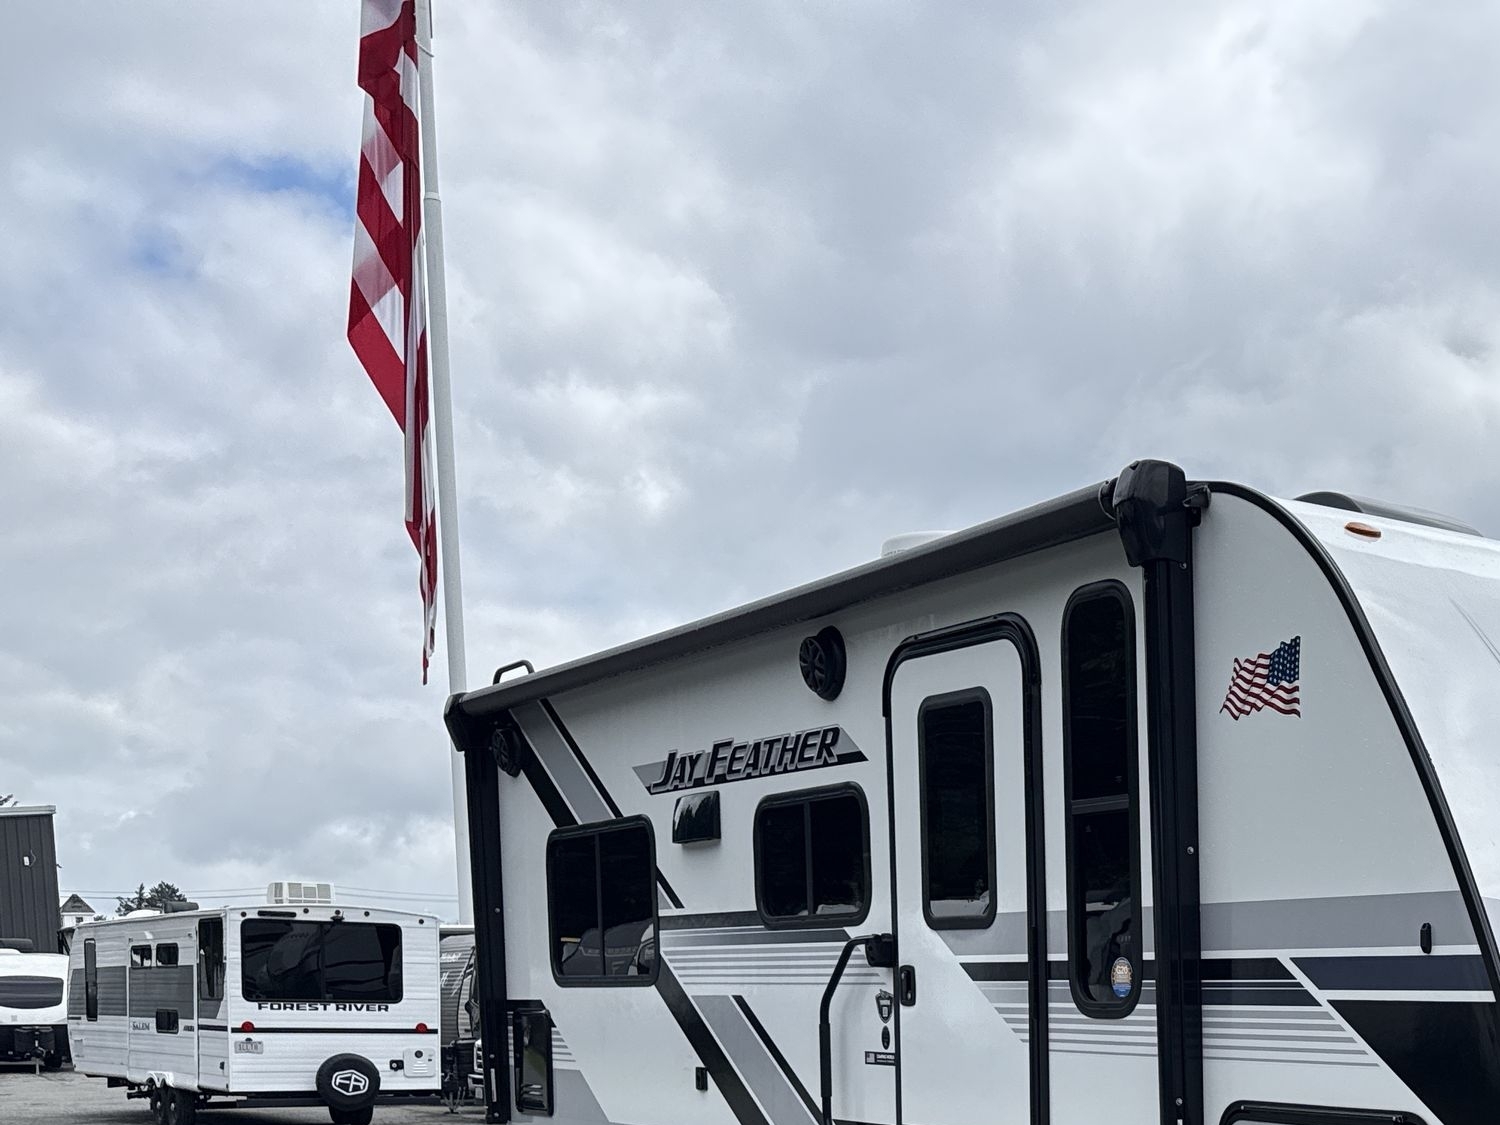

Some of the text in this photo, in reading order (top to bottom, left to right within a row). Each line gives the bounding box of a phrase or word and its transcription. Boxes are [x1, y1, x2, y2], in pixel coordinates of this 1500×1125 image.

[651, 724, 841, 792] JAY FEATHER
[257, 1002, 389, 1012] FOREST RIVER
